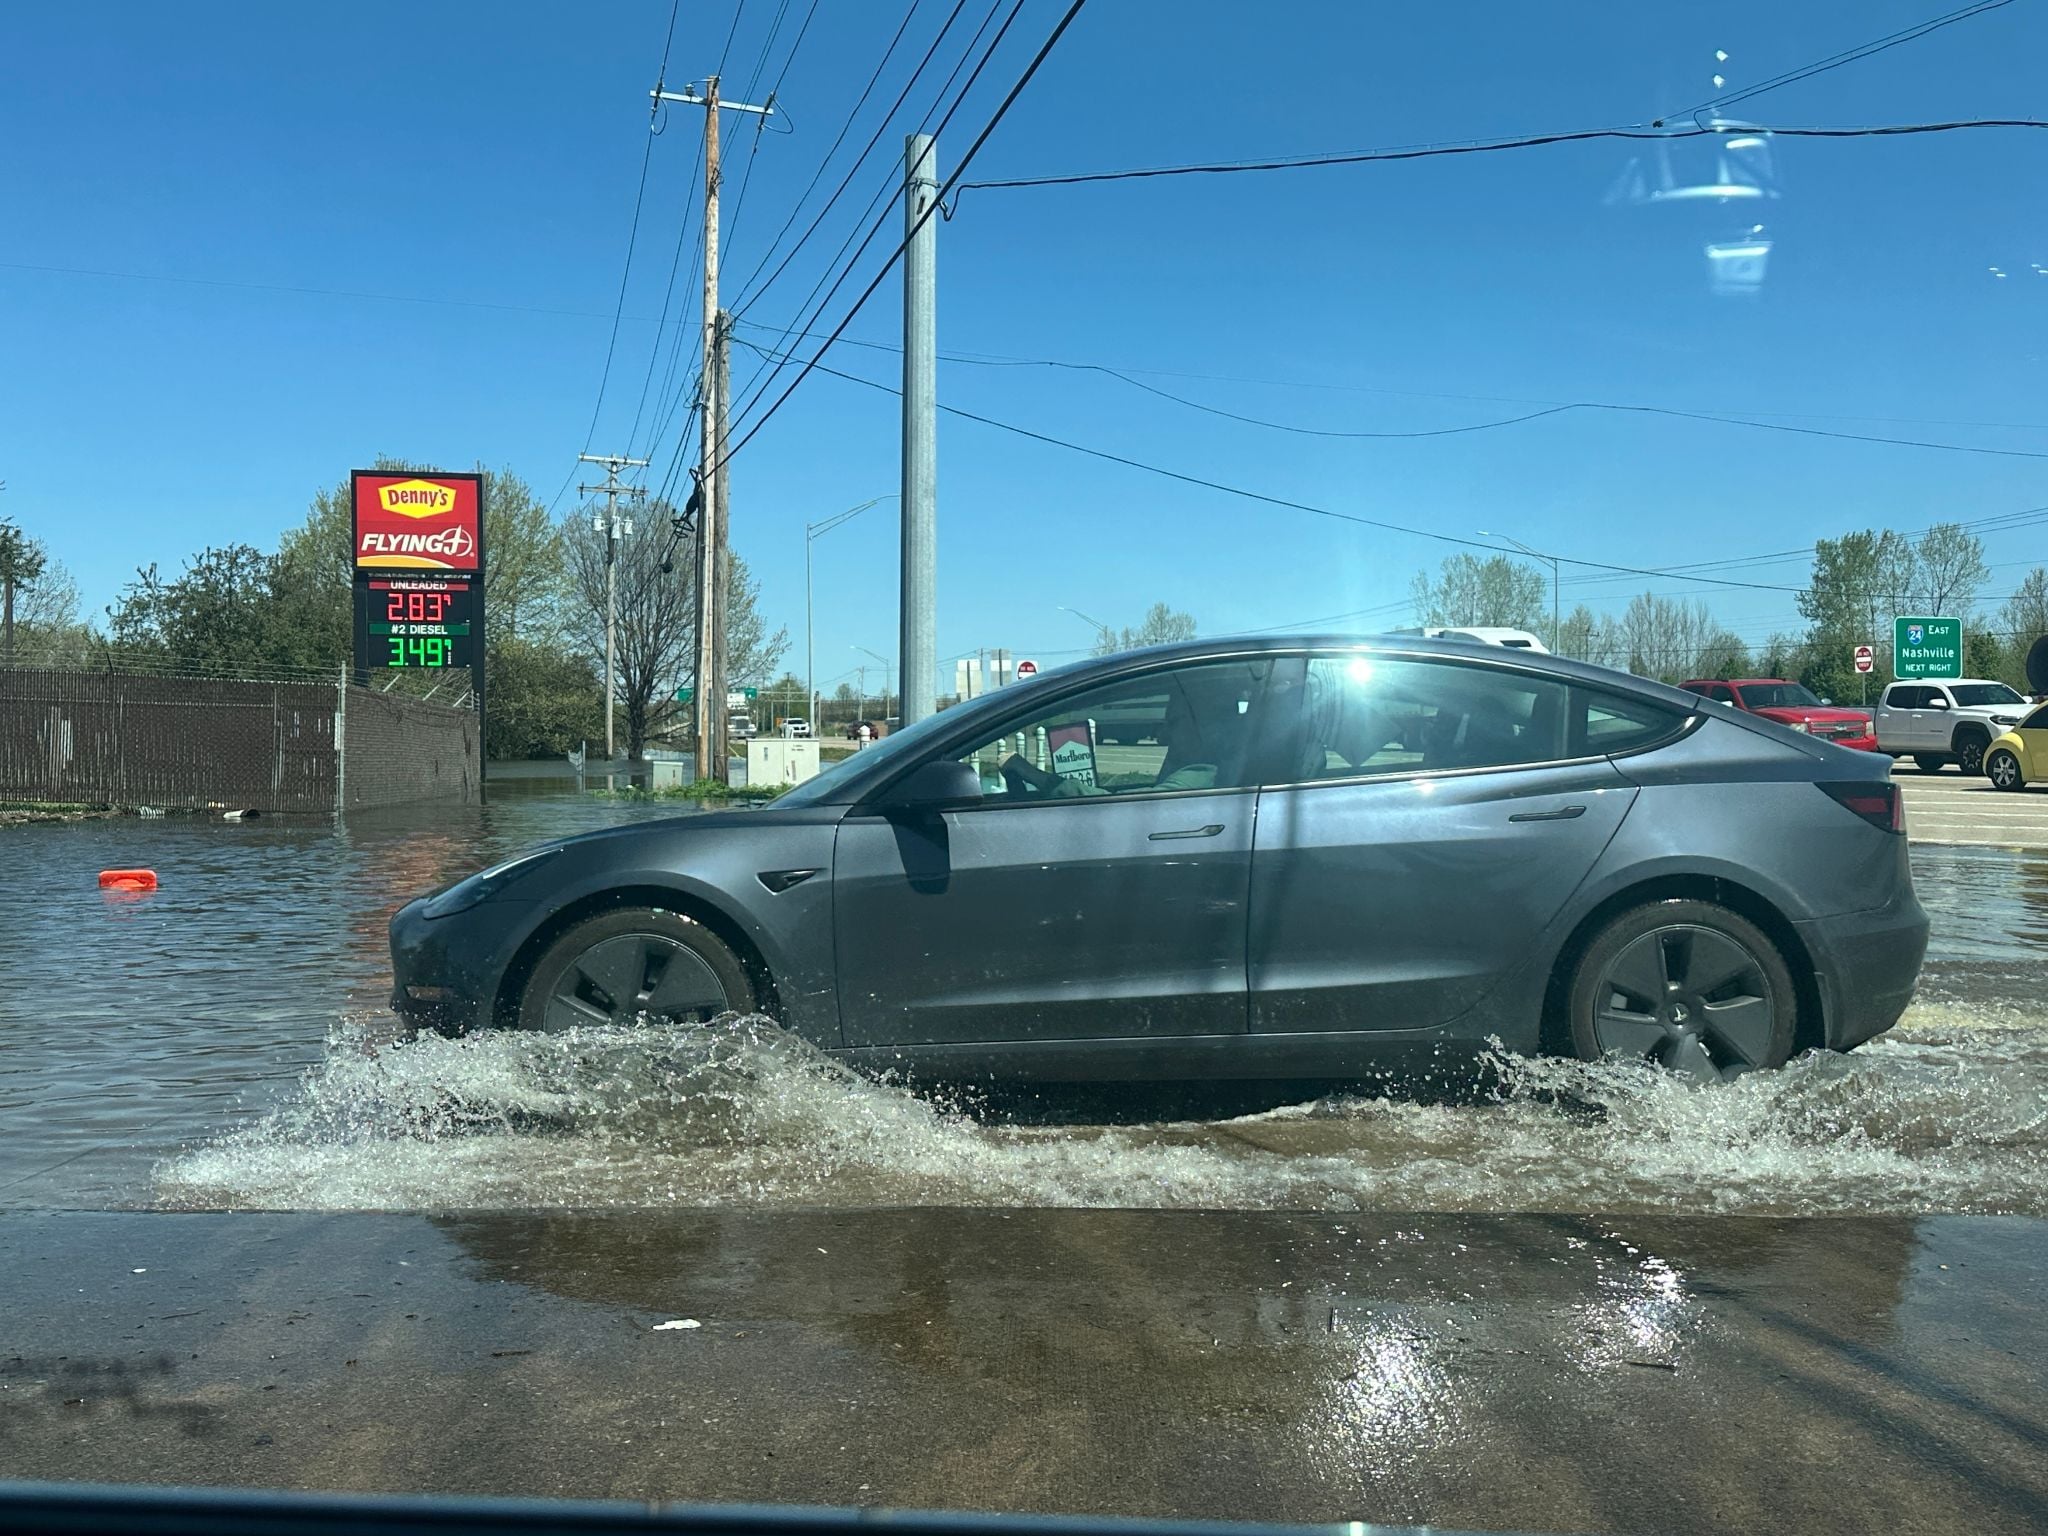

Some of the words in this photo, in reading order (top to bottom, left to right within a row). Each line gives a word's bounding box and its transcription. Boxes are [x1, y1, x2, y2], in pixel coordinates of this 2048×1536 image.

[387, 488, 449, 508] Denny's
[390, 580, 449, 590] UNLEADED
[391, 624, 406, 634] #2
[409, 625, 448, 635] DIESEL
[1909, 630, 1922, 641] 24
[1902, 647, 1955, 658] Nashville
[1905, 663, 1926, 672] NEXT
[1928, 663, 1952, 672] RIGHT
[1055, 749, 1091, 763] Marlboro
